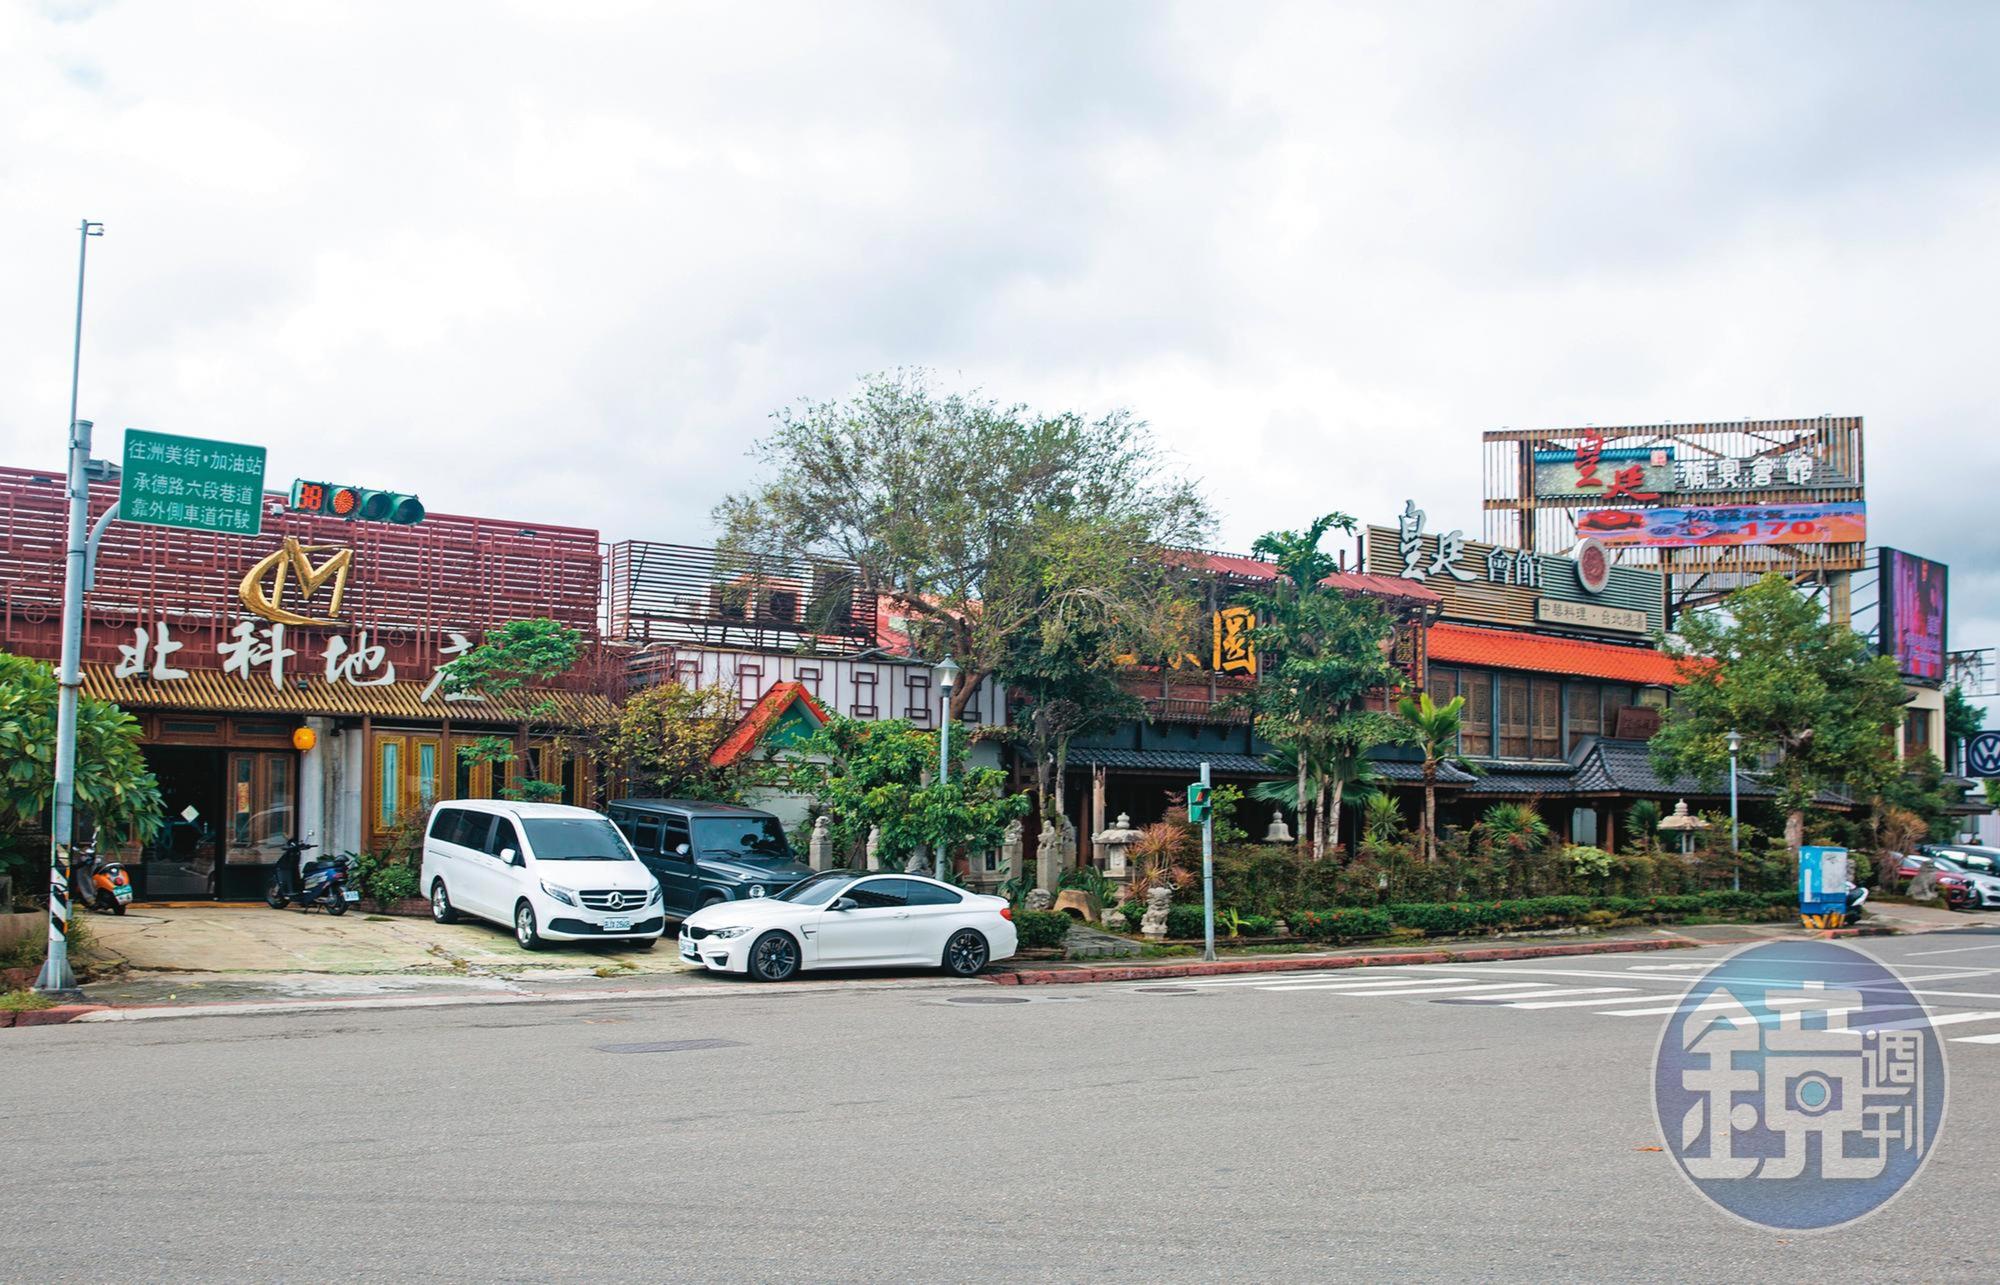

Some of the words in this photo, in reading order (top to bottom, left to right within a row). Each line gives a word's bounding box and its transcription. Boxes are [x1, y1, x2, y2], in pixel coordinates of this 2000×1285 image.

[133, 471, 254, 505] 承德路六段巷道
[131, 497, 250, 529] 靠外側車道行駛
